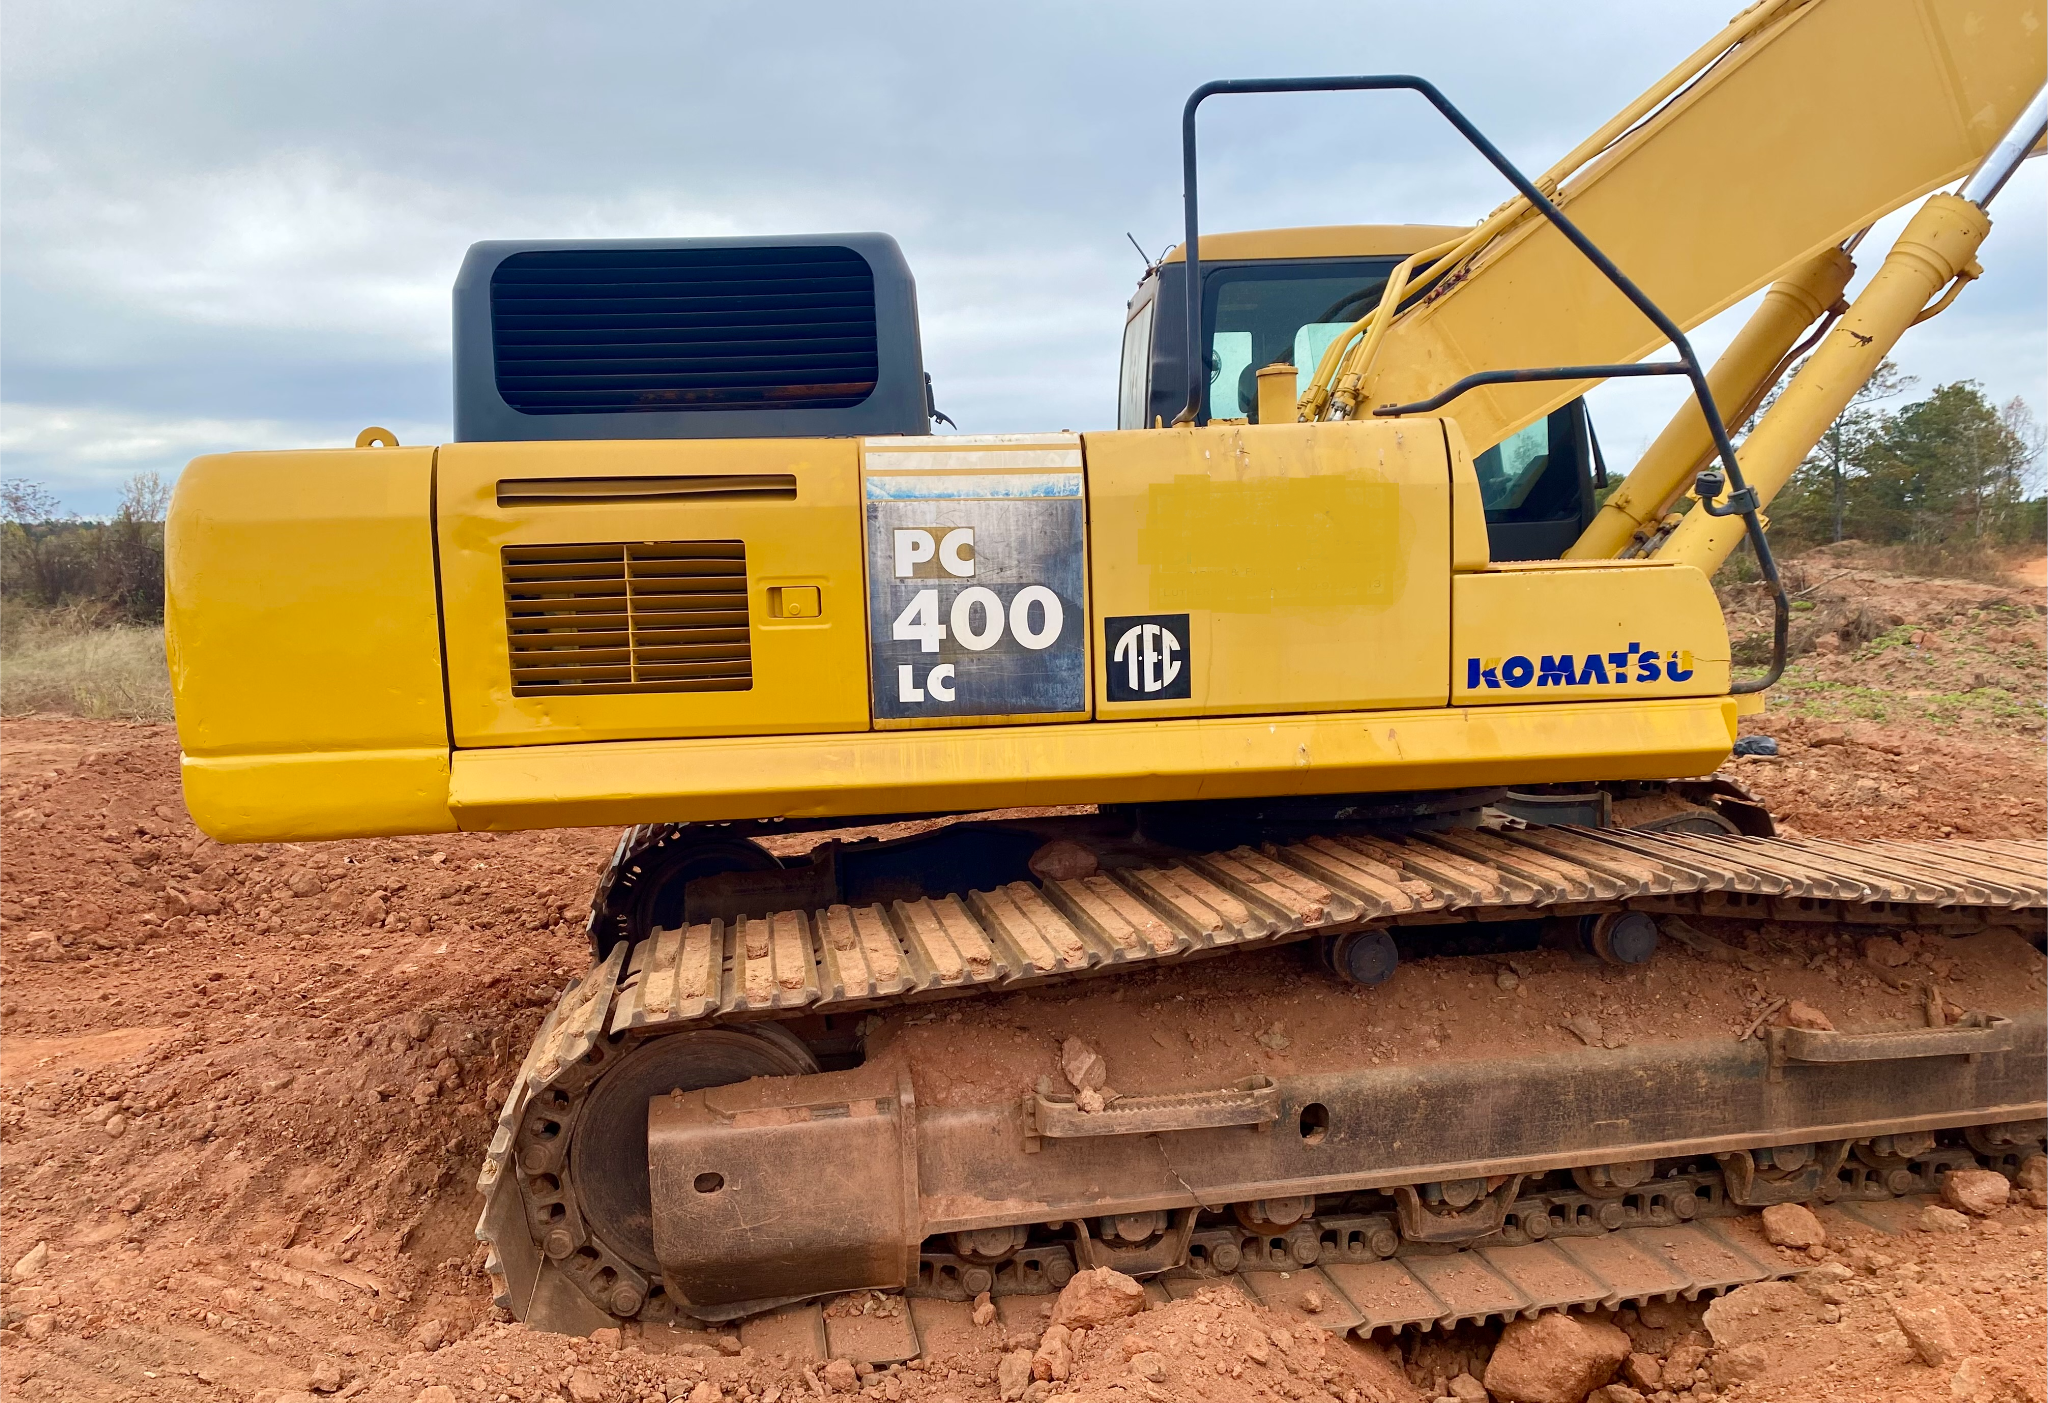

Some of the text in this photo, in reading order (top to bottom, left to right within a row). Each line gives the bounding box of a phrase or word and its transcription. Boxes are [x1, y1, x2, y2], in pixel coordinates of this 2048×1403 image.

[893, 528, 975, 578] PC
[892, 585, 1064, 653] 400
[898, 664, 956, 702] LC
[1467, 641, 1694, 690] KOMATSU
